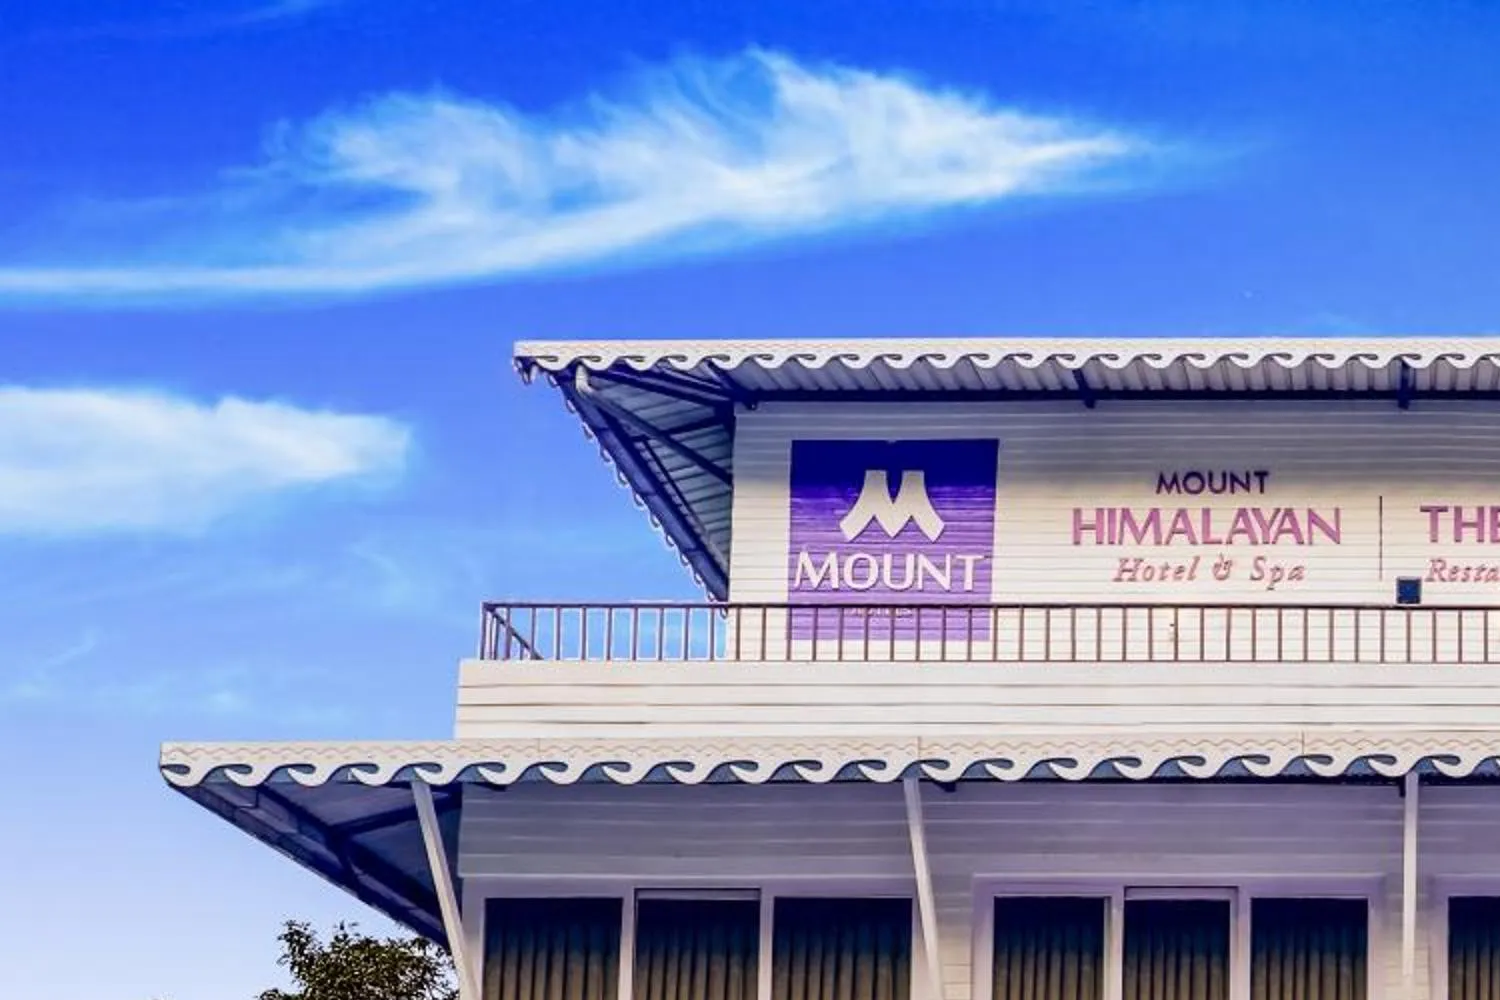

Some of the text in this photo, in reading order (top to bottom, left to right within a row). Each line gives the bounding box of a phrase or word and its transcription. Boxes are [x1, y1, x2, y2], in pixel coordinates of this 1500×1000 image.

[1155, 471, 1269, 494] MOUNT
[1072, 507, 1341, 545] HIMALAYAN
[794, 551, 985, 592] MOUNT
[1113, 553, 1306, 590] Hotel & Spa
